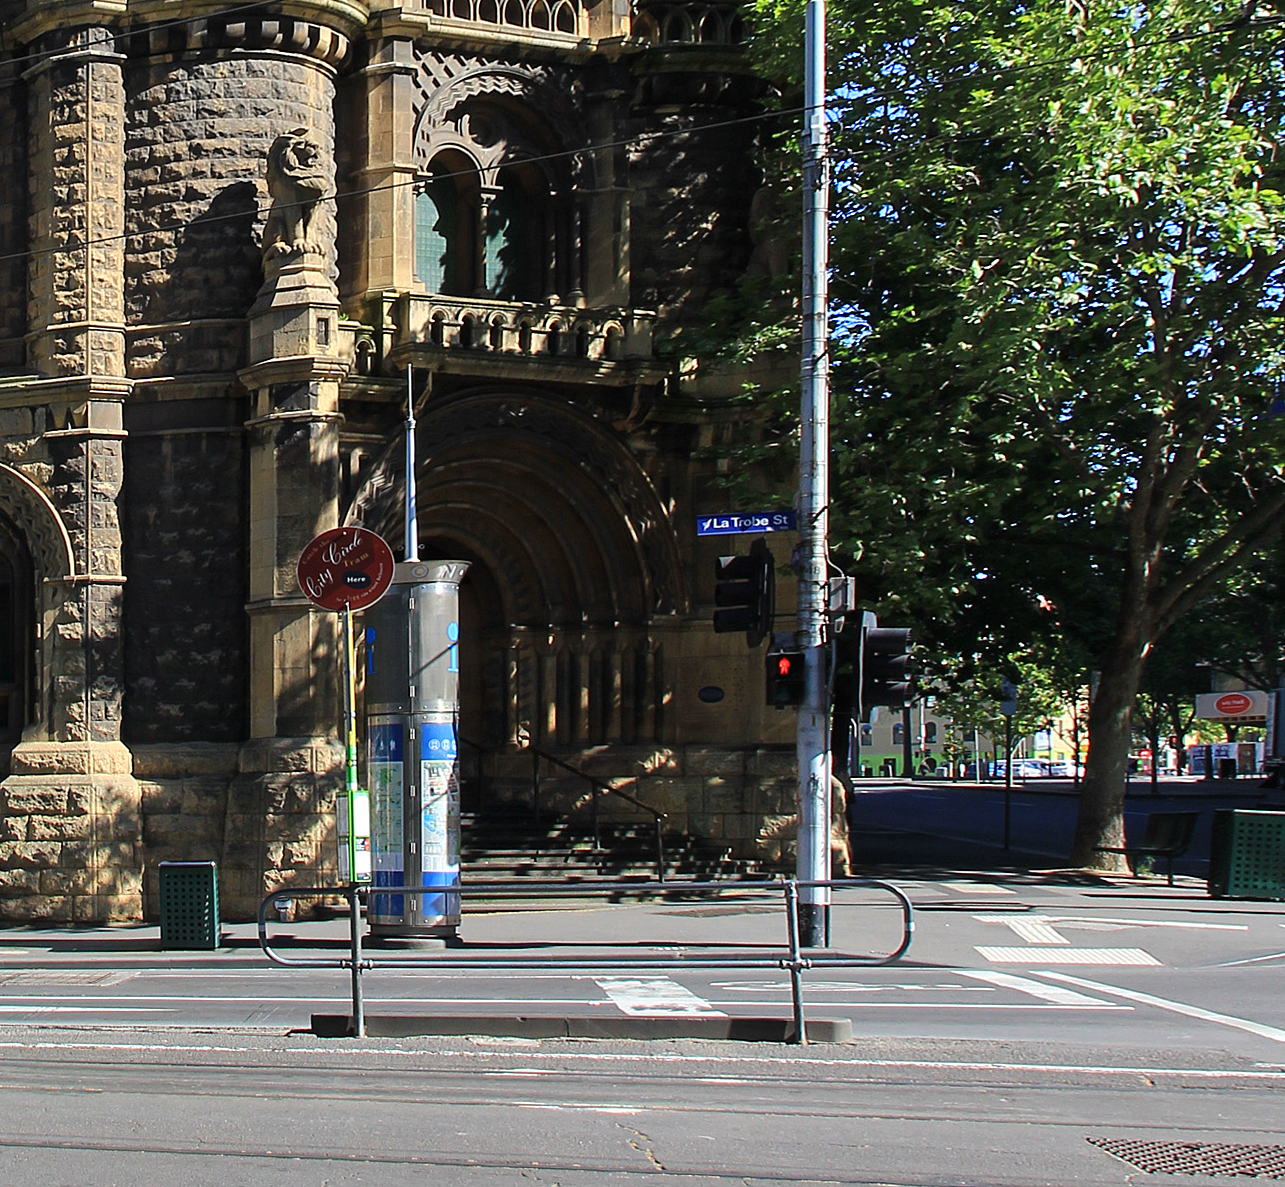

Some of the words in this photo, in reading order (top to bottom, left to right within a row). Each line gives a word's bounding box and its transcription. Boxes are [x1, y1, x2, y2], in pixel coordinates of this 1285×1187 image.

[713, 518, 729, 529] La
[731, 516, 769, 528] Trobe
[773, 514, 788, 525] St
[306, 568, 333, 598] City
[322, 529, 363, 565] Circle
[346, 576, 366, 584] Here
